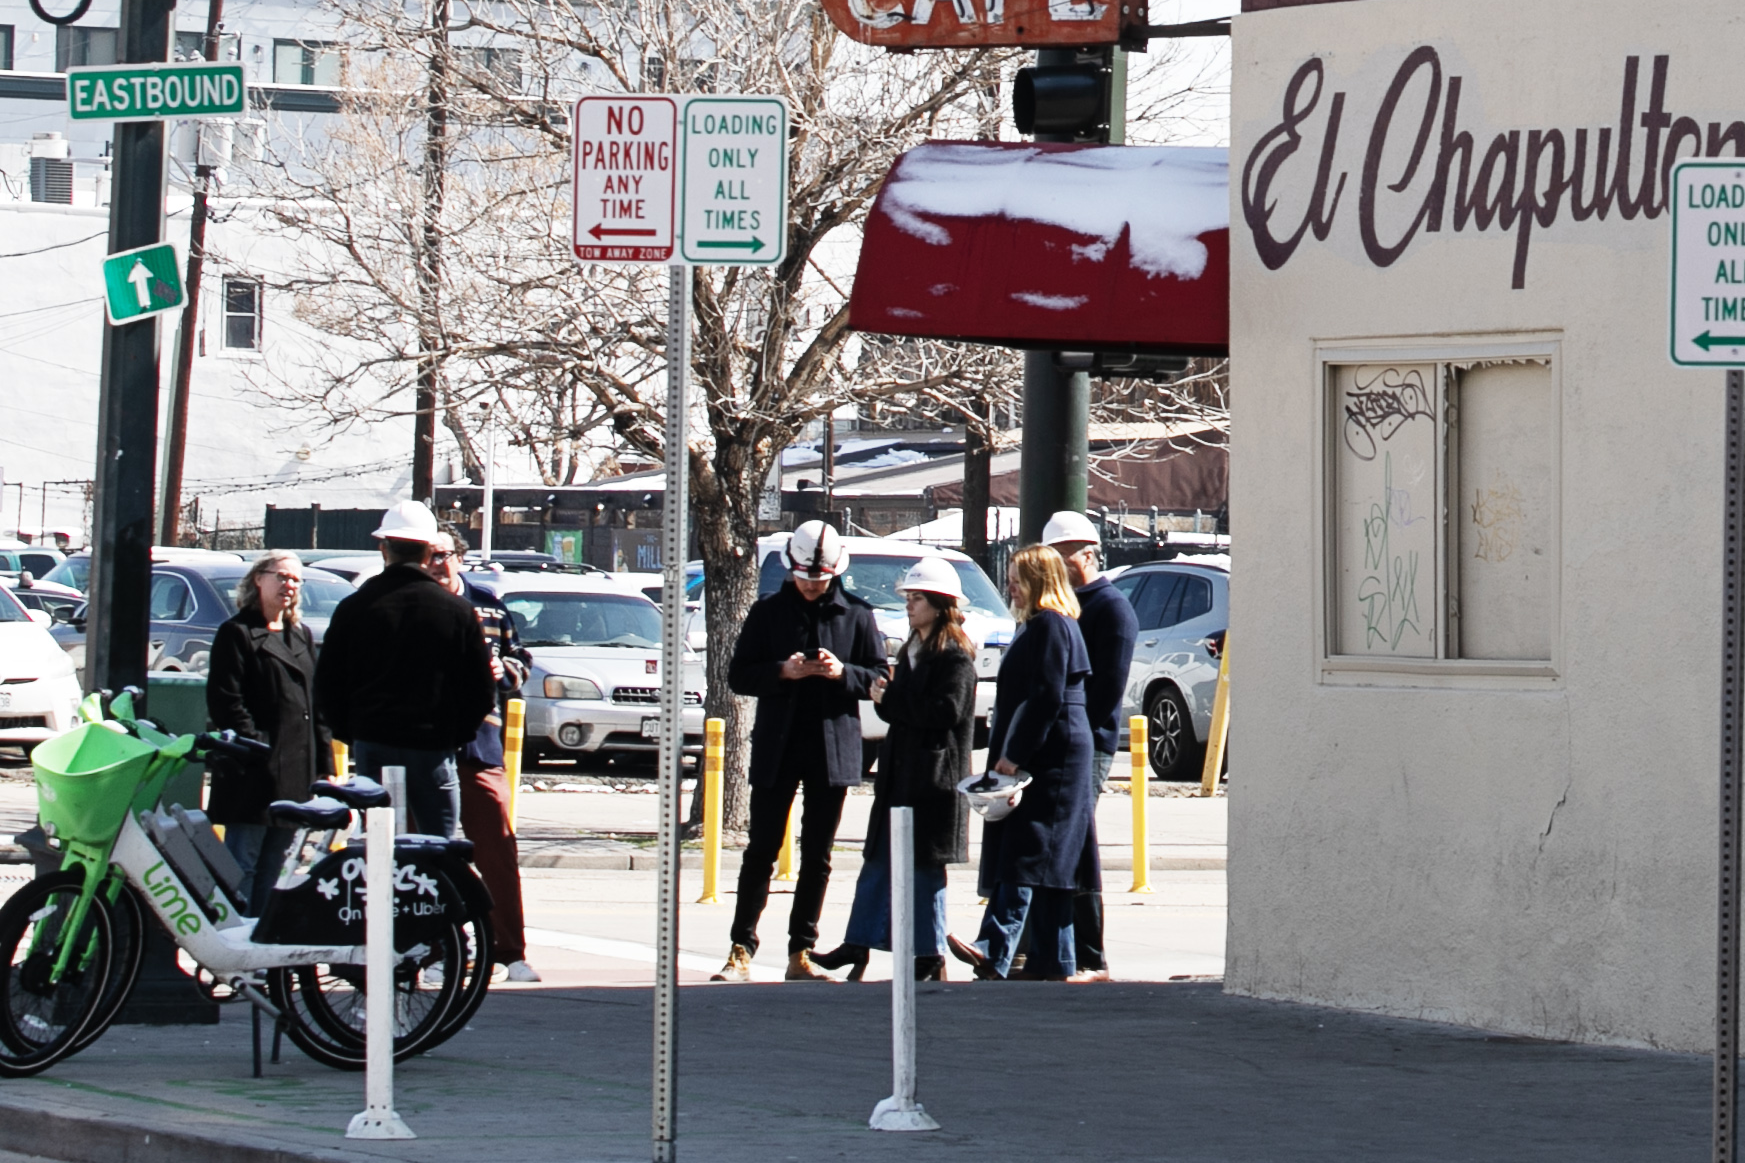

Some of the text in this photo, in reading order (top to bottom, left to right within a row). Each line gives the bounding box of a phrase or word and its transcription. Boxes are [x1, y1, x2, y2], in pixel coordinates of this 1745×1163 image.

[74, 74, 240, 112] EASTBOUND
[606, 105, 644, 136] NO
[691, 114, 777, 135] LOADING
[582, 140, 669, 171] PARKING
[708, 148, 759, 168] ONLY
[1242, 57, 1347, 270] El
[603, 174, 643, 195] ANY
[714, 180, 750, 200] ALL
[600, 199, 645, 219] TIME
[704, 210, 761, 230] TIMES
[579, 247, 667, 259] TOW AWAY ZONE
[143, 860, 201, 936] Lime
[413, 901, 447, 917] Uber
